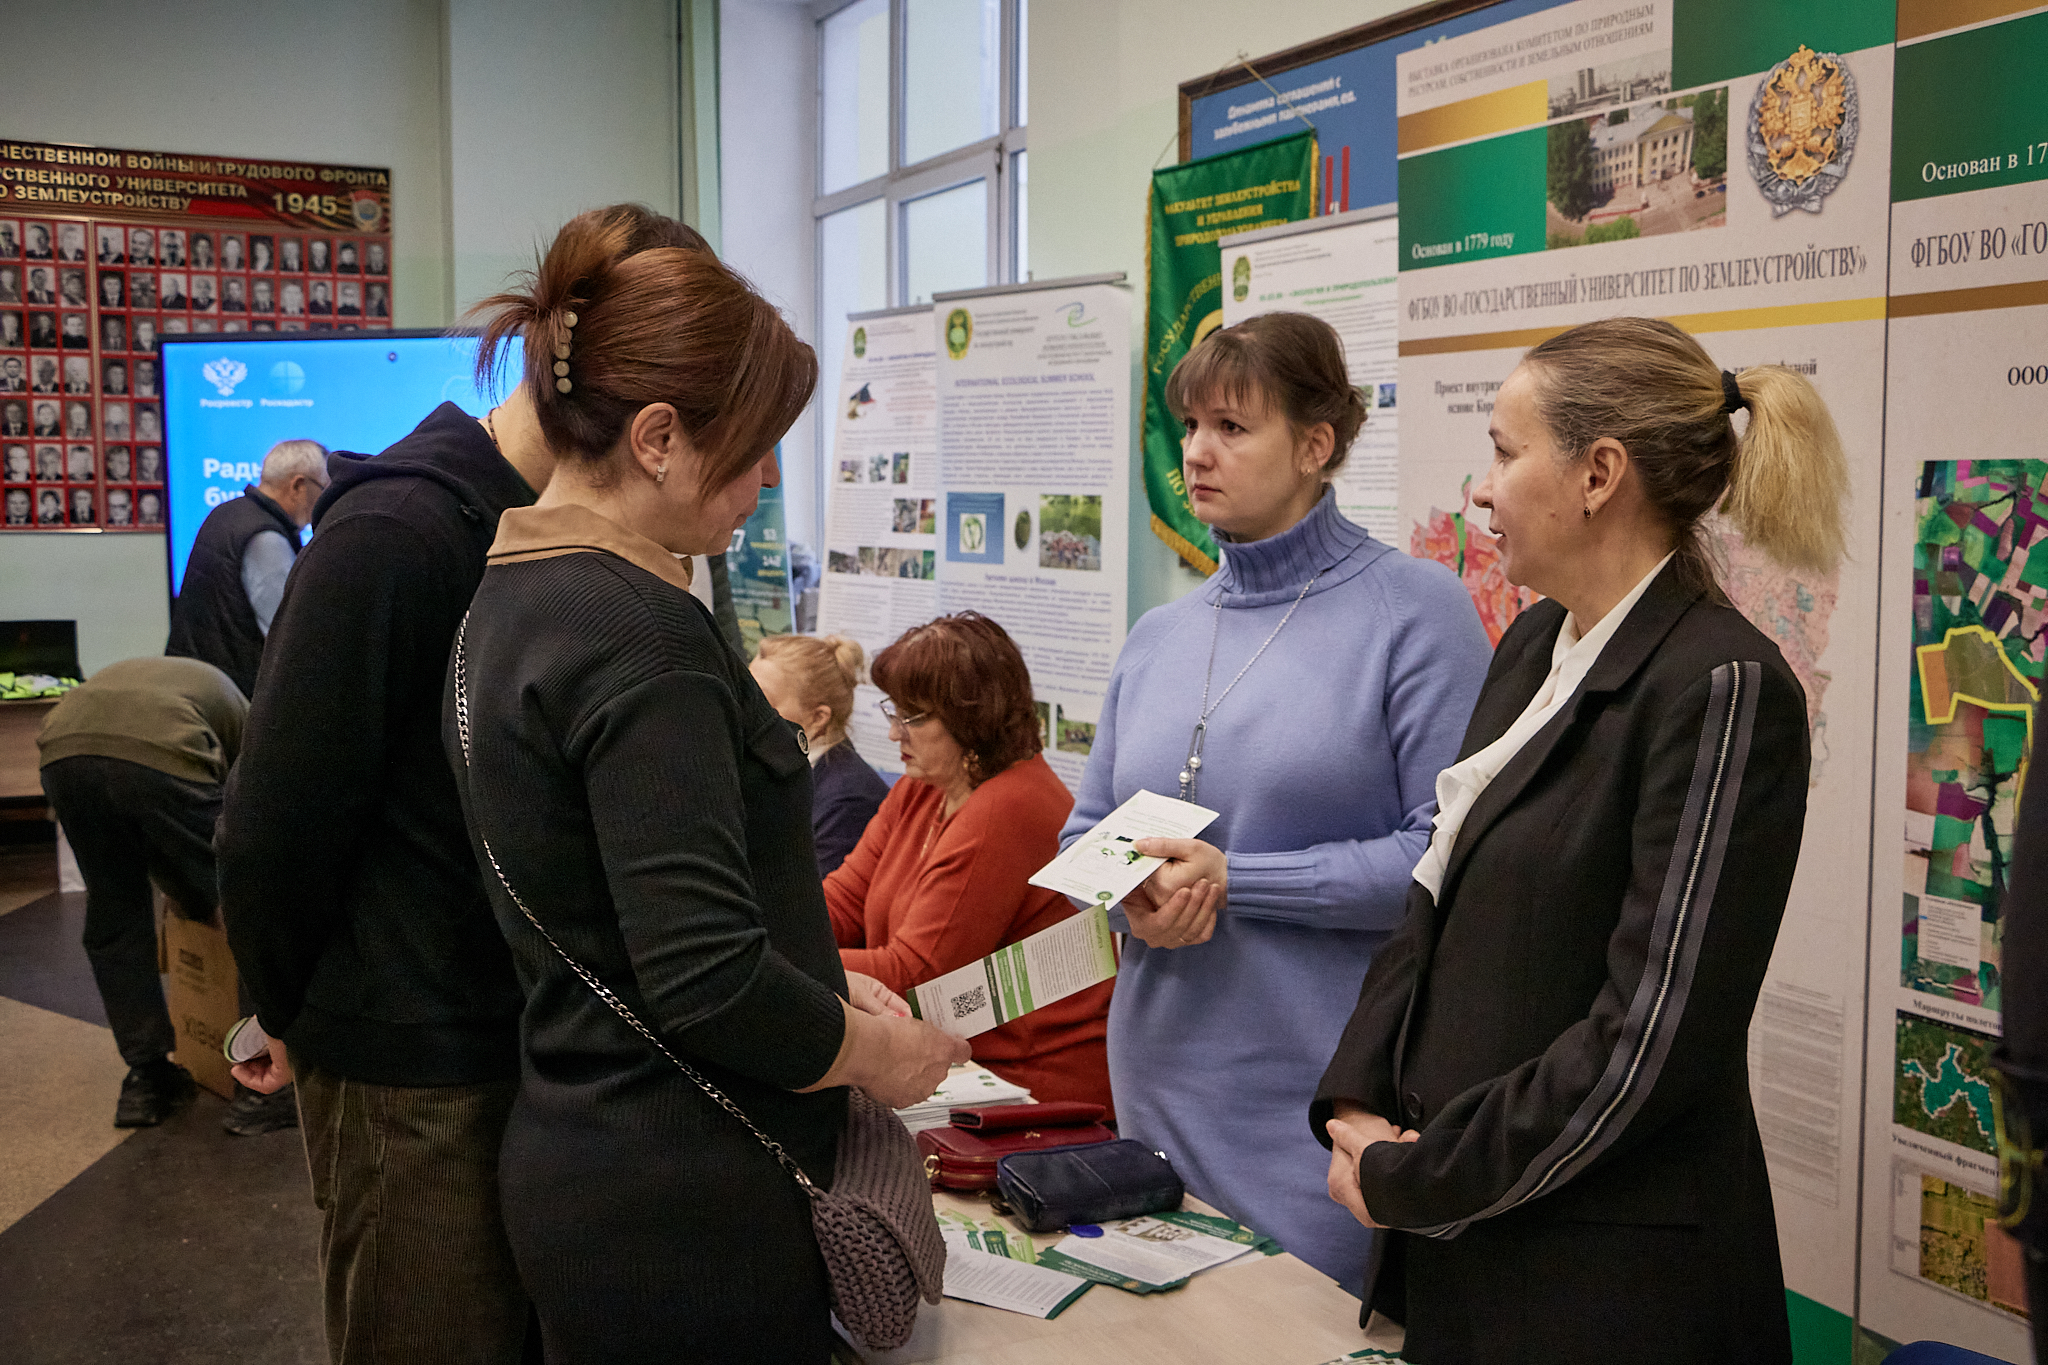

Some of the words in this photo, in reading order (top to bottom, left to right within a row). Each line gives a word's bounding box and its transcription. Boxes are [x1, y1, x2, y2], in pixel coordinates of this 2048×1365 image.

[1591, 3, 1654, 31] ПРИРОДНЫМ
[1583, 21, 1654, 51] ОТНОШЕНИЯМ
[0, 167, 110, 188] СТВЕННОГО
[116, 175, 248, 197] УНИВЕРСИТЕТА
[126, 152, 193, 173] ВОЙНЫ
[200, 160, 211, 174] И
[216, 162, 316, 181] ТРУДОВОГО
[319, 169, 388, 186] ФРОНТА
[1922, 156, 2001, 182] Основан
[2007, 153, 2018, 169] в
[14, 185, 192, 210] ЗЕМЛЕУСТРОЙСТВУ
[273, 193, 338, 216] 1945
[1411, 241, 1453, 260] Основан
[1465, 232, 1488, 251] 1779
[1490, 232, 1515, 249] году
[1911, 230, 1975, 268] ФГБОУ
[1979, 227, 2006, 260] ВО
[1443, 293, 1457, 318] ВО
[1580, 266, 1676, 303] УНИВЕРСИТЕТ
[1679, 264, 1700, 292] ПО
[1703, 243, 1867, 291] ЗЕМЛЕУСТРОЙСТВУ»
